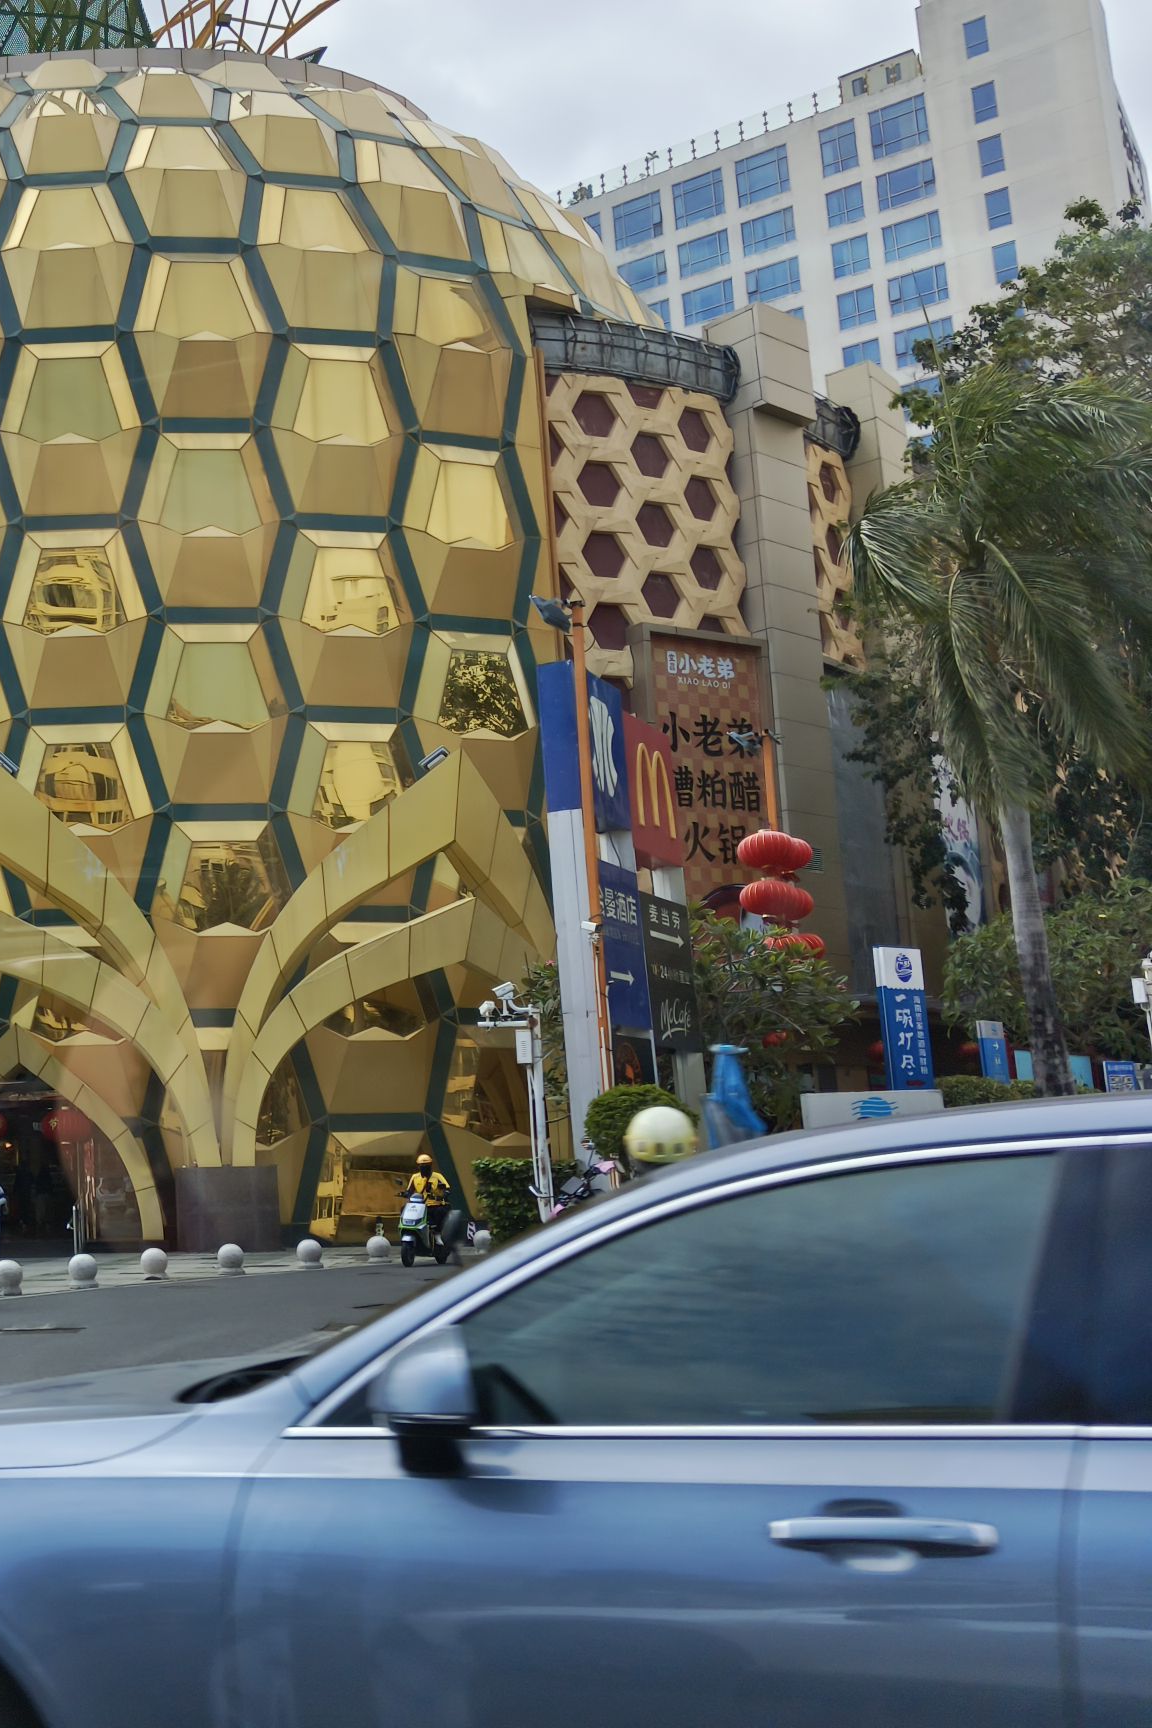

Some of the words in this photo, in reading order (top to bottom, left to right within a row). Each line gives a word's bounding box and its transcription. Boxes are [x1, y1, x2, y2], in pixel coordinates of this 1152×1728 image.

[677, 676, 699, 686] XIAO
[702, 679, 719, 688] LAO
[722, 681, 731, 689] DI
[649, 904, 681, 930] 麦当劳
